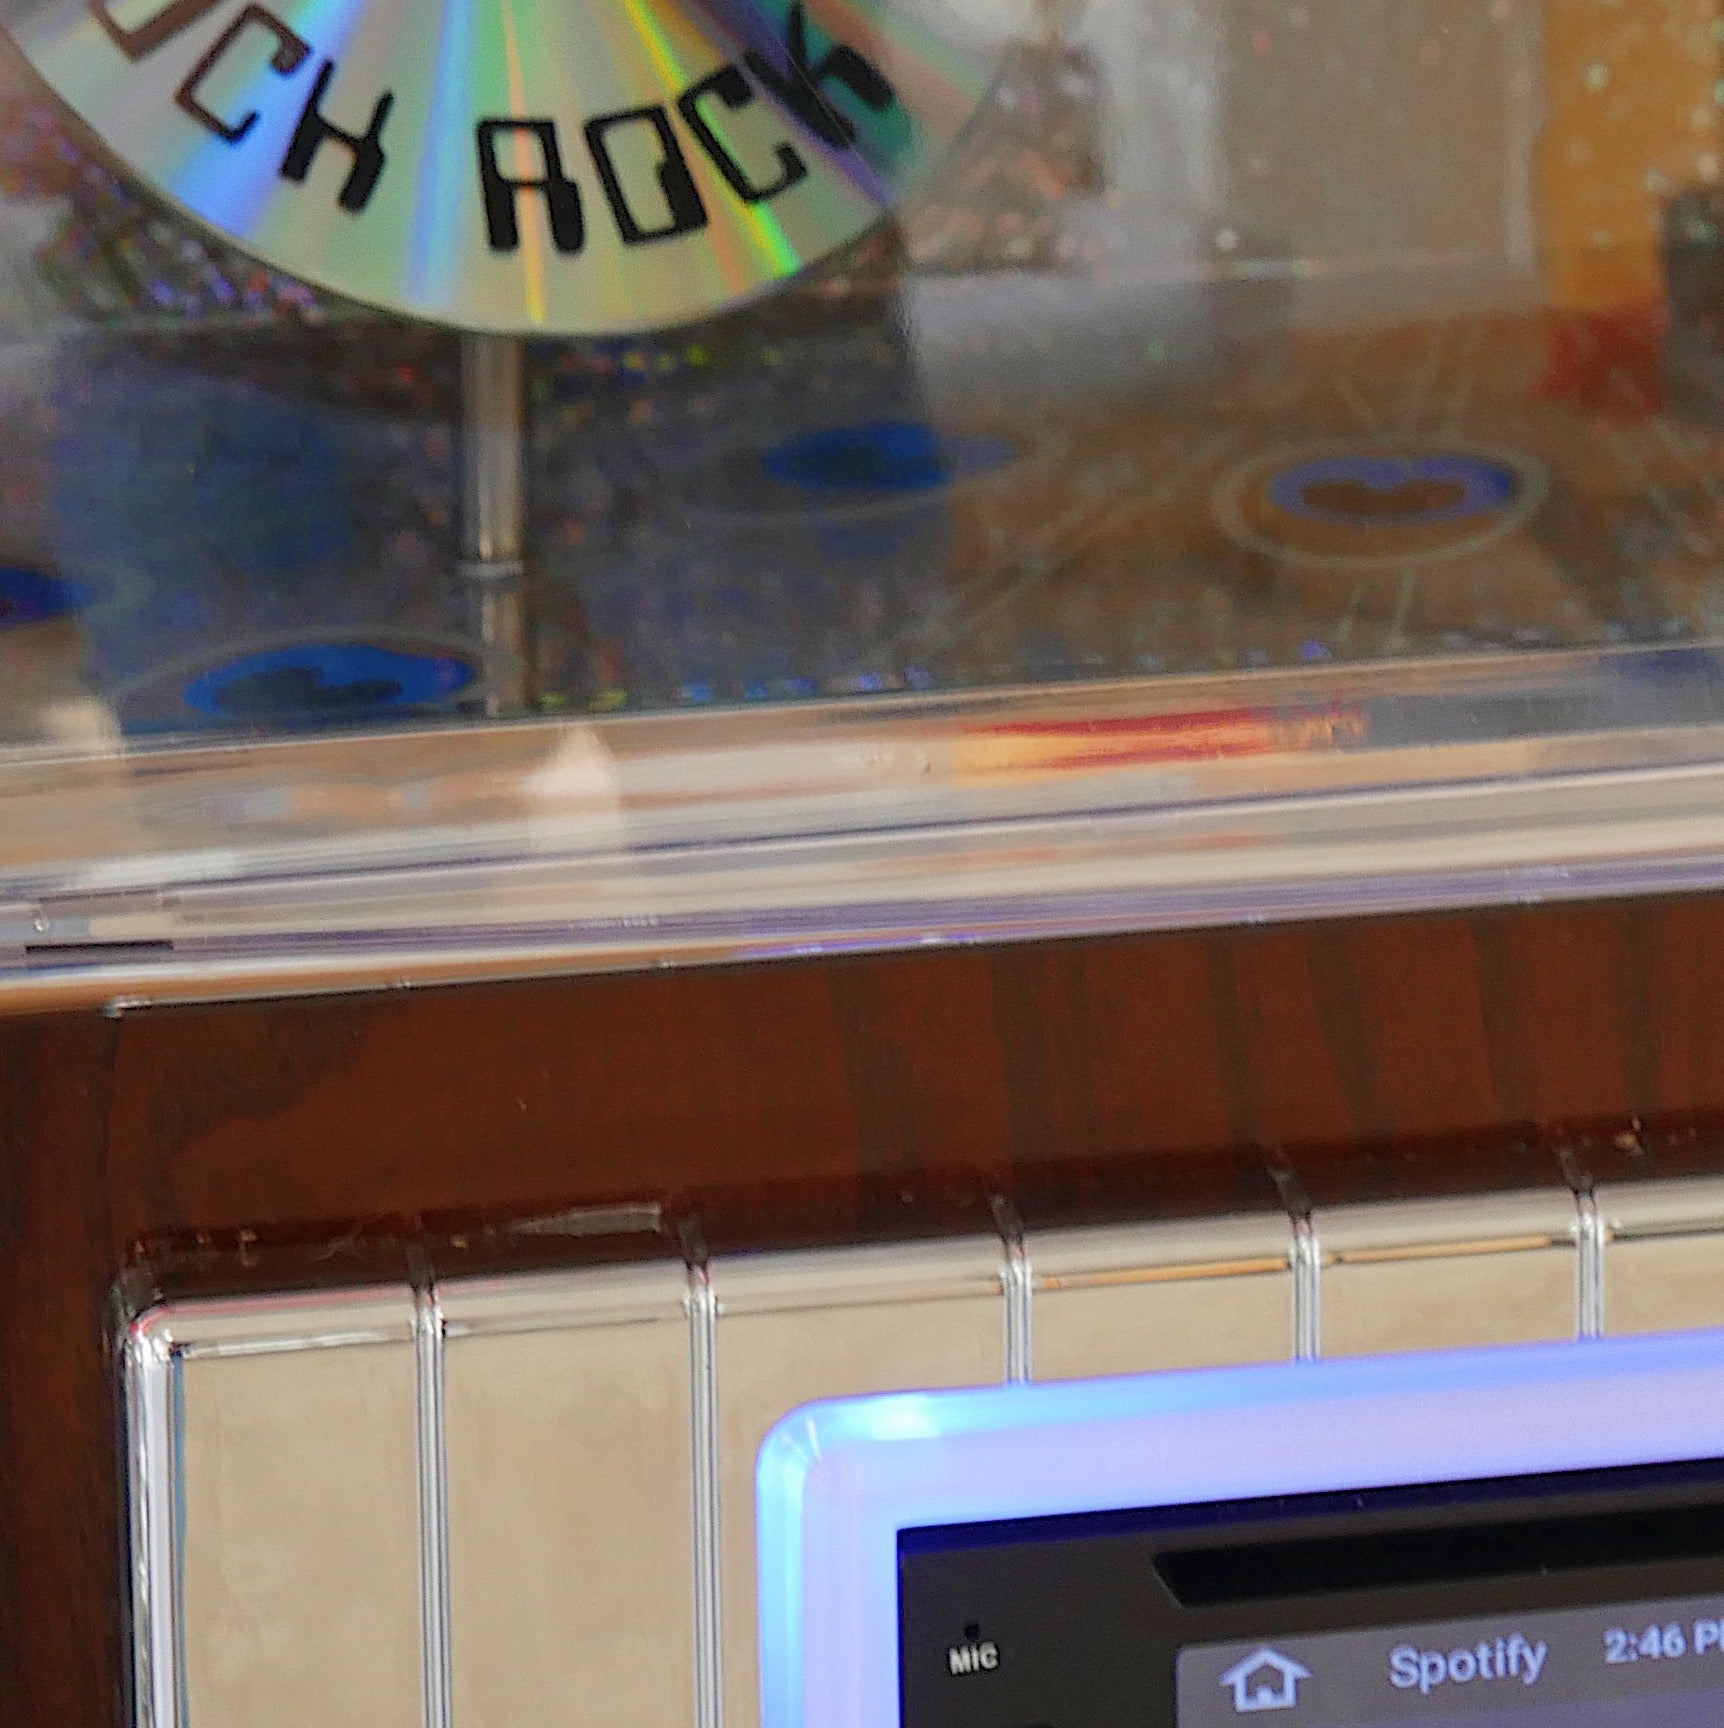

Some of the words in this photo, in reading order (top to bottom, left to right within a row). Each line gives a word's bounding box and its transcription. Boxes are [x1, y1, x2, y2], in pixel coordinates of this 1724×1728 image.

[949, 1641, 999, 1675] MIC
[1388, 1631, 1548, 1695] Spotify
[1604, 1621, 1687, 1663] 2:46
